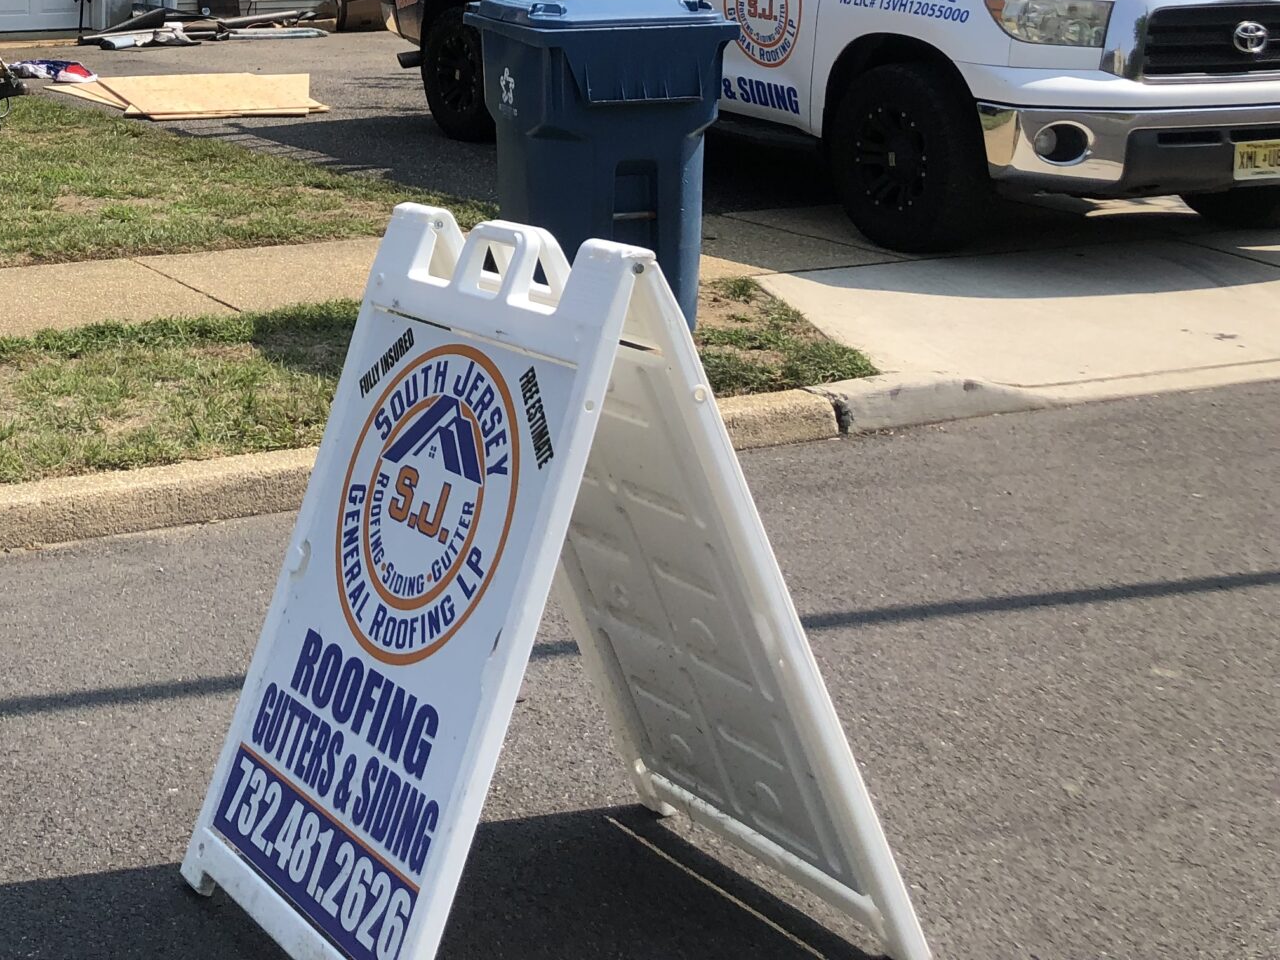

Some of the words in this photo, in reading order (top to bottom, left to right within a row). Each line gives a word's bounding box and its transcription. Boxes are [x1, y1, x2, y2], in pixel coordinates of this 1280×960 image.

[727, 7, 756, 57] GRAL
[759, 38, 791, 63] ROOFING
[790, 18, 797, 38] LP
[738, 1, 754, 36] ROOFING
[722, 77, 737, 100] &
[737, 76, 800, 115] SIDING
[359, 361, 380, 398] FULLY
[380, 327, 414, 377] INSURED
[519, 365, 540, 406] FREE
[374, 360, 448, 440] SOUTH
[453, 361, 508, 475] JERSEY
[526, 396, 554, 470] ESTIMATE
[370, 472, 390, 565] ROOFING
[382, 562, 424, 597] SIDING
[431, 501, 475, 583] GUTTER
[388, 464, 452, 545] S.J.
[343, 483, 370, 623] GENERAL
[368, 595, 456, 649] ROOFING
[456, 546, 484, 600] LP
[290, 628, 439, 780] ROOFING
[252, 682, 344, 798] GUTTERS
[332, 753, 358, 813] &
[352, 756, 439, 876] SIDING
[224, 756, 412, 960] 732.481.2626
